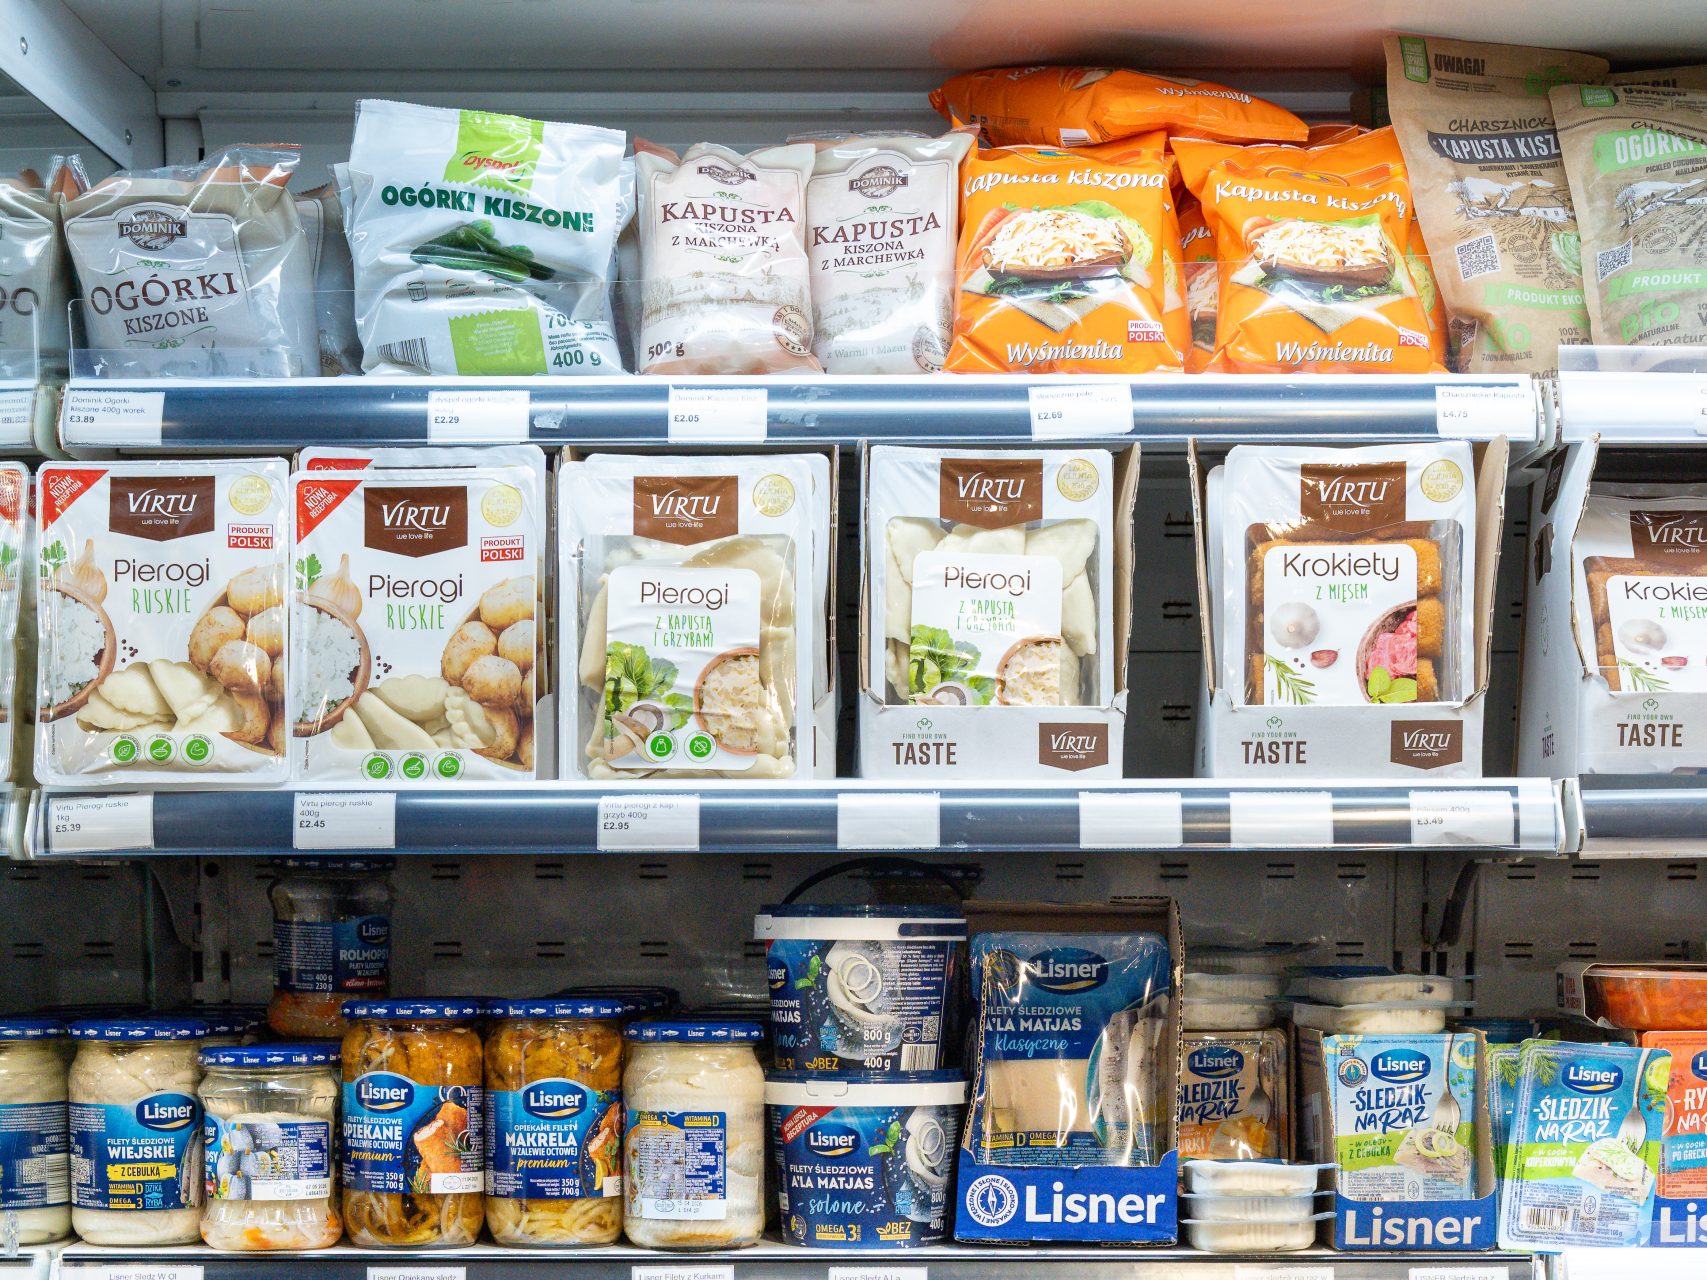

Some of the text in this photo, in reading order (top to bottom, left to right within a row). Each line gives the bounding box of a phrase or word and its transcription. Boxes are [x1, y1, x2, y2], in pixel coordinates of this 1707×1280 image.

[1434, 54, 1485, 76] UWAGA!
[1439, 136, 1516, 160] KAPUSTA
[852, 176, 904, 190] DOMINIK
[381, 185, 595, 233] OGÓRKI KISZONE
[1215, 183, 1406, 219] Kapusta kiszona
[661, 203, 796, 224] KAPUSTA
[122, 223, 184, 236] DOMINIK
[812, 211, 941, 247] KAPUSTA
[672, 236, 780, 252] Z MARCHEWKĄ
[843, 240, 904, 255] KISZONA
[822, 248, 925, 270] Z MARCHEWKĄ
[1632, 273, 1701, 288] PRODUKT
[89, 271, 238, 316] OGÓRKI
[125, 306, 209, 335] KISZONE
[1007, 340, 1123, 365] Wyśmienita
[1276, 340, 1393, 364] Wyśmienita
[72, 396, 130, 406] Dominik Ogorki
[70, 406, 146, 416] kiszone 400g worek
[674, 414, 699, 423] £2.05
[1037, 411, 1063, 420] £2.69
[1443, 410, 1468, 418] £4.75
[69, 415, 95, 424] £3.89
[434, 415, 460, 424] £2.29
[957, 473, 1025, 503] VIRTU
[127, 490, 196, 514] VIRTU
[651, 492, 721, 521] VIRTU
[382, 501, 451, 530] VIRTU
[231, 525, 270, 535] PRODUKT
[229, 536, 272, 548] POLSKI
[113, 559, 210, 587] Pierogi
[1282, 551, 1400, 581] Krokiety
[369, 574, 463, 603] Pierogi
[943, 566, 1032, 595] Pierogi
[640, 580, 729, 610] Pierogi
[1316, 583, 1368, 602] Z MIĘSEM
[132, 588, 192, 614] RUSKIE
[387, 604, 446, 630] RUSKIE
[655, 615, 713, 632] Z KAPUSTĄ
[663, 631, 714, 647] GRZYBAMI
[892, 742, 957, 766] TASTE
[56, 800, 129, 813] Virtu Pierogi ruskie
[56, 813, 70, 822] 1kg
[603, 811, 648, 820] grzyb 400g
[1417, 817, 1443, 826] £3.49
[55, 823, 81, 833] £5.39
[299, 820, 326, 829] £2.45
[603, 822, 629, 830] £2.95
[1036, 959, 1101, 978] Lisner
[1020, 1017, 1081, 1031] MATJAS
[1377, 1057, 1426, 1073] Lisner
[360, 1085, 409, 1101] Lisner
[529, 1091, 582, 1107] Lisner
[144, 1104, 193, 1120] Lisner
[343, 1124, 402, 1140] OPIEKANE
[505, 1132, 578, 1147] MAKRELA
[810, 1132, 856, 1147] Lisner
[107, 1137, 175, 1147] FILETY ŚLEDZIOWE
[107, 1146, 176, 1159] WIEJSKIE
[790, 1163, 874, 1175] FILETY ŚLEDZIOWE
[818, 1176, 874, 1190] MATJAS
[1025, 1182, 1166, 1224] Lisner
